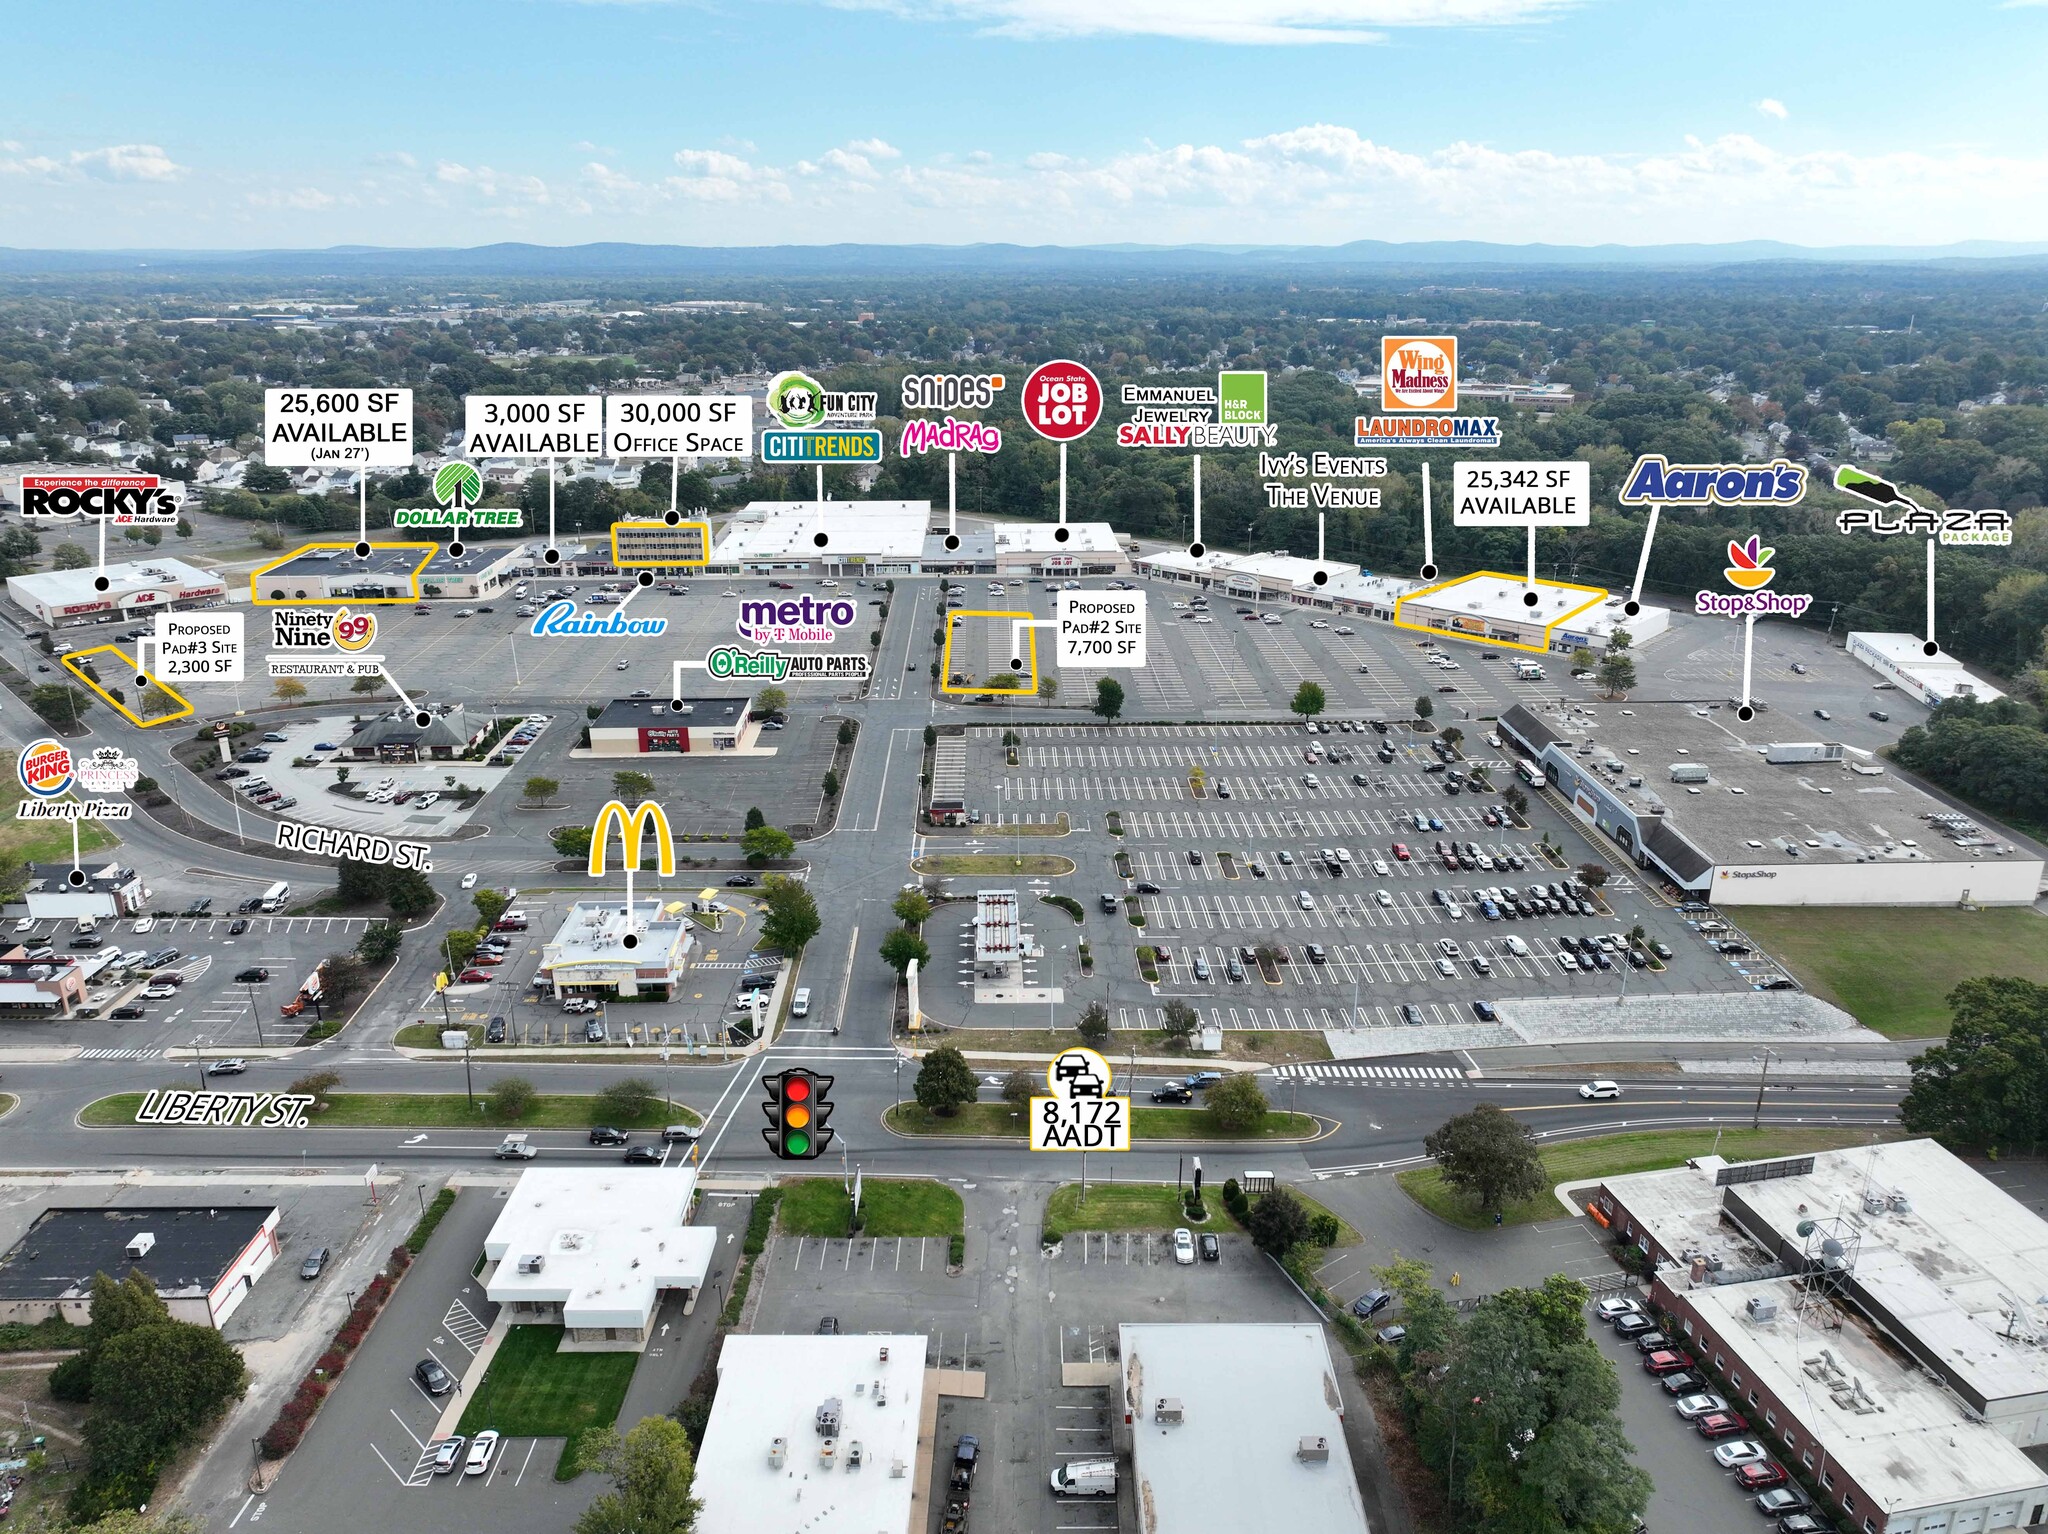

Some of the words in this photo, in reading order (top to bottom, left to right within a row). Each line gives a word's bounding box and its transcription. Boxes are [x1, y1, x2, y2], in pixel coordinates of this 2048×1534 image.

[135, 592, 156, 604] ACE
[179, 588, 220, 598] Hardware
[1732, 870, 1777, 879] Stop&Shop
[250, 1502, 268, 1522] STOP
